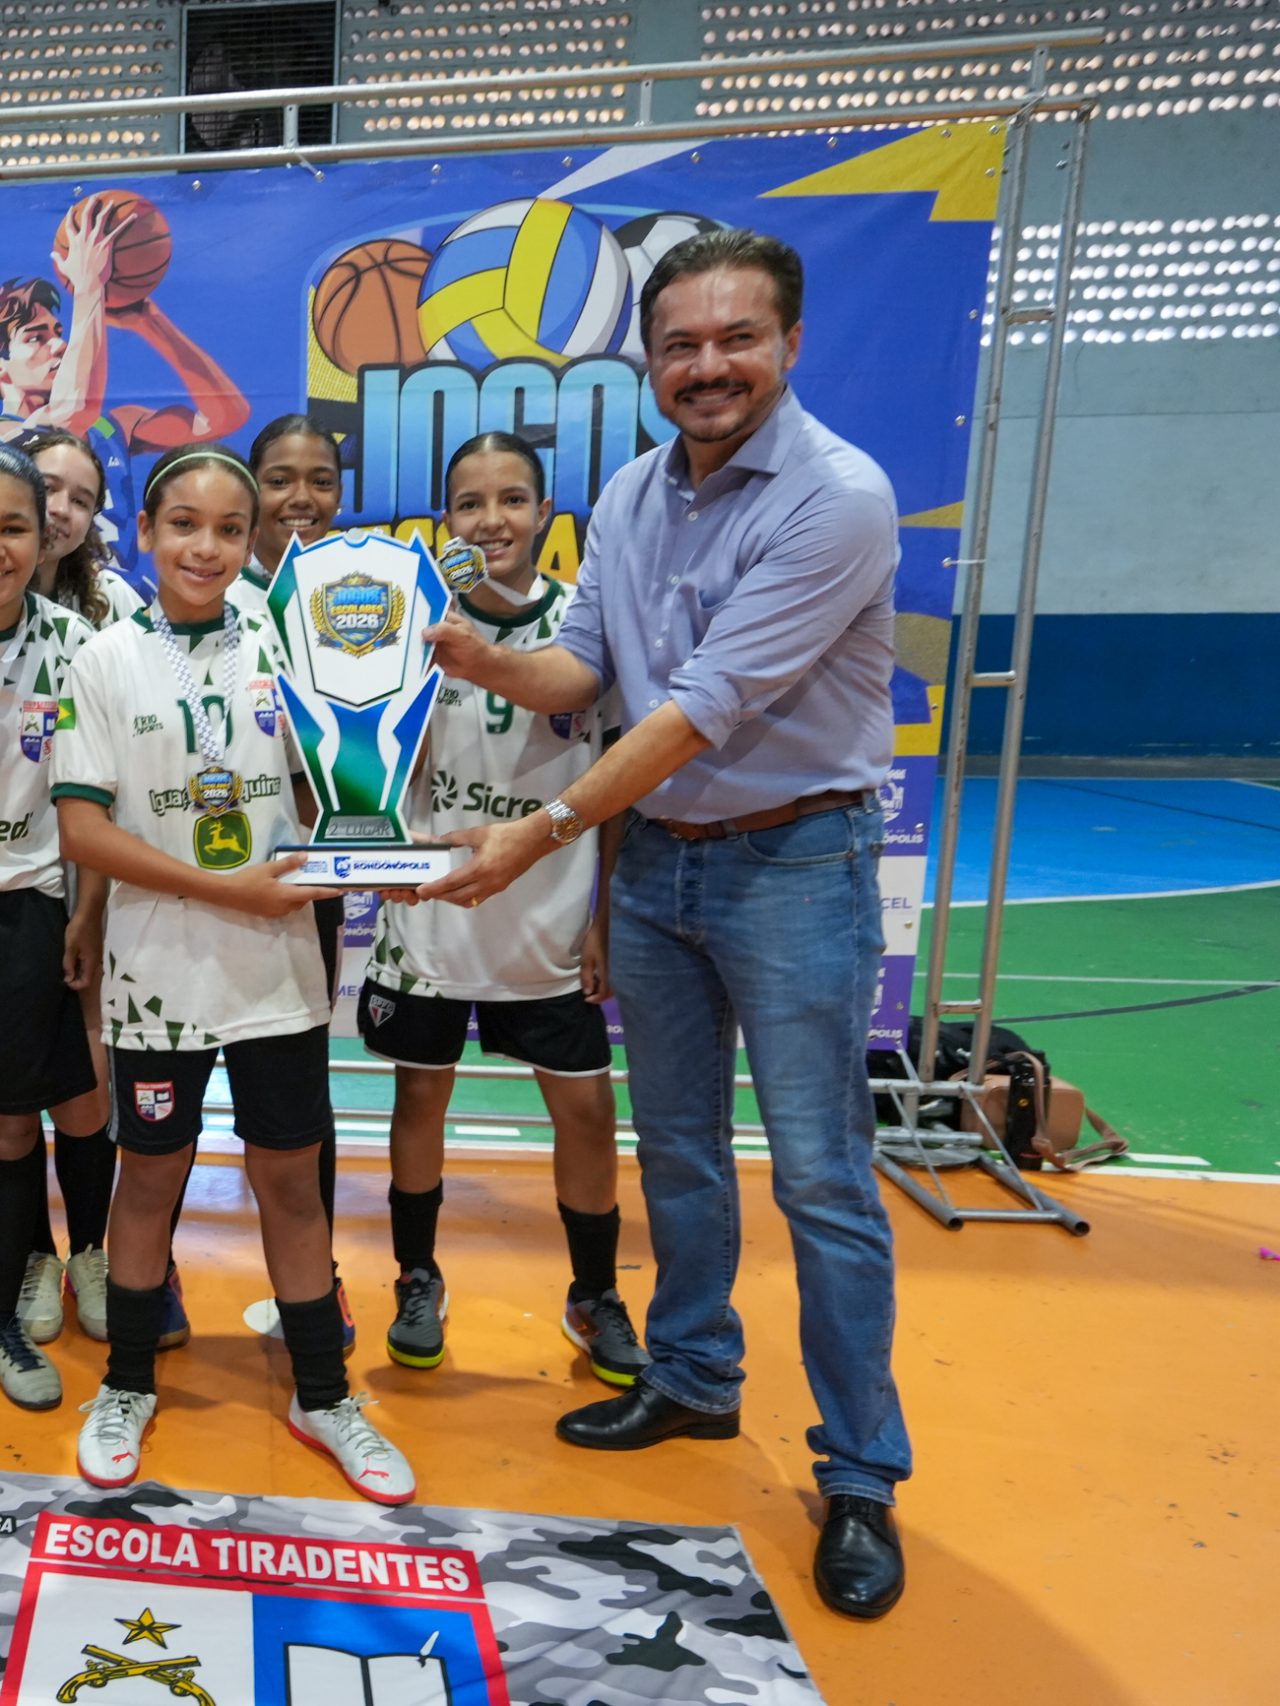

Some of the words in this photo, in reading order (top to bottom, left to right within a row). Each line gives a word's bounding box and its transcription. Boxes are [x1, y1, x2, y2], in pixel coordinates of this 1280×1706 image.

[336, 614, 379, 630] 2026
[149, 787, 191, 817] Iguaç
[463, 782, 543, 818] Sicre
[44, 1522, 199, 1569] ESCOLA
[211, 1538, 471, 1592] TIRADENTES
